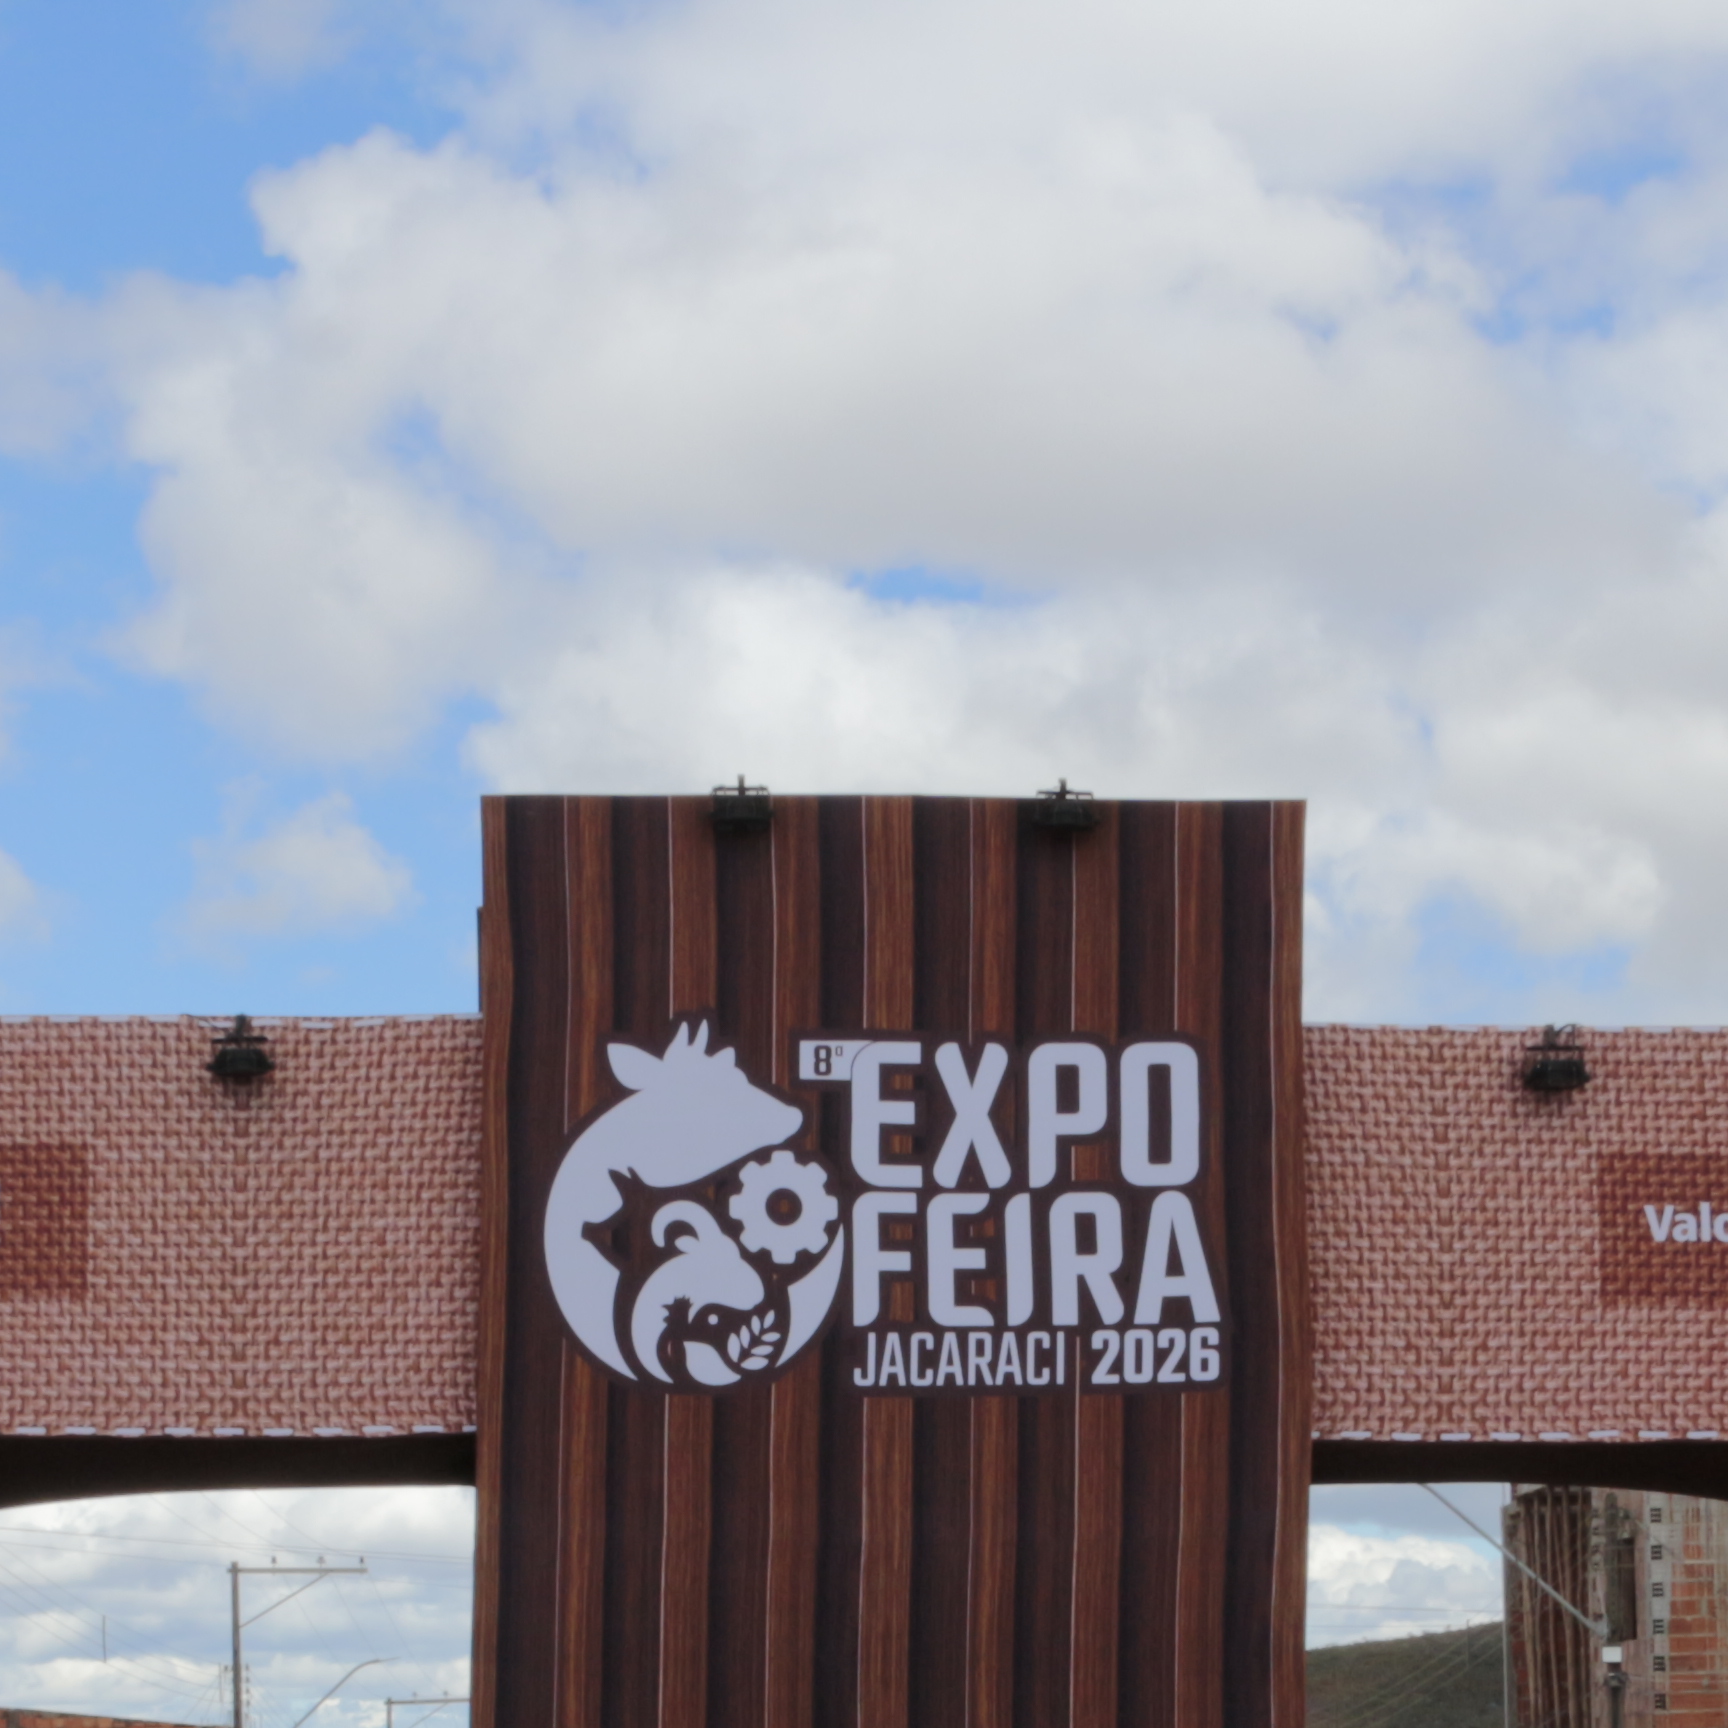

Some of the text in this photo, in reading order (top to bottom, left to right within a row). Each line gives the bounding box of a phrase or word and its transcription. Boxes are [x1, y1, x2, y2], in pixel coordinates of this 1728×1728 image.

[851, 1041, 1200, 1188] EXPO
[852, 1190, 1221, 1327] FEIRA
[853, 1327, 1220, 1386] JACARACI 2026
